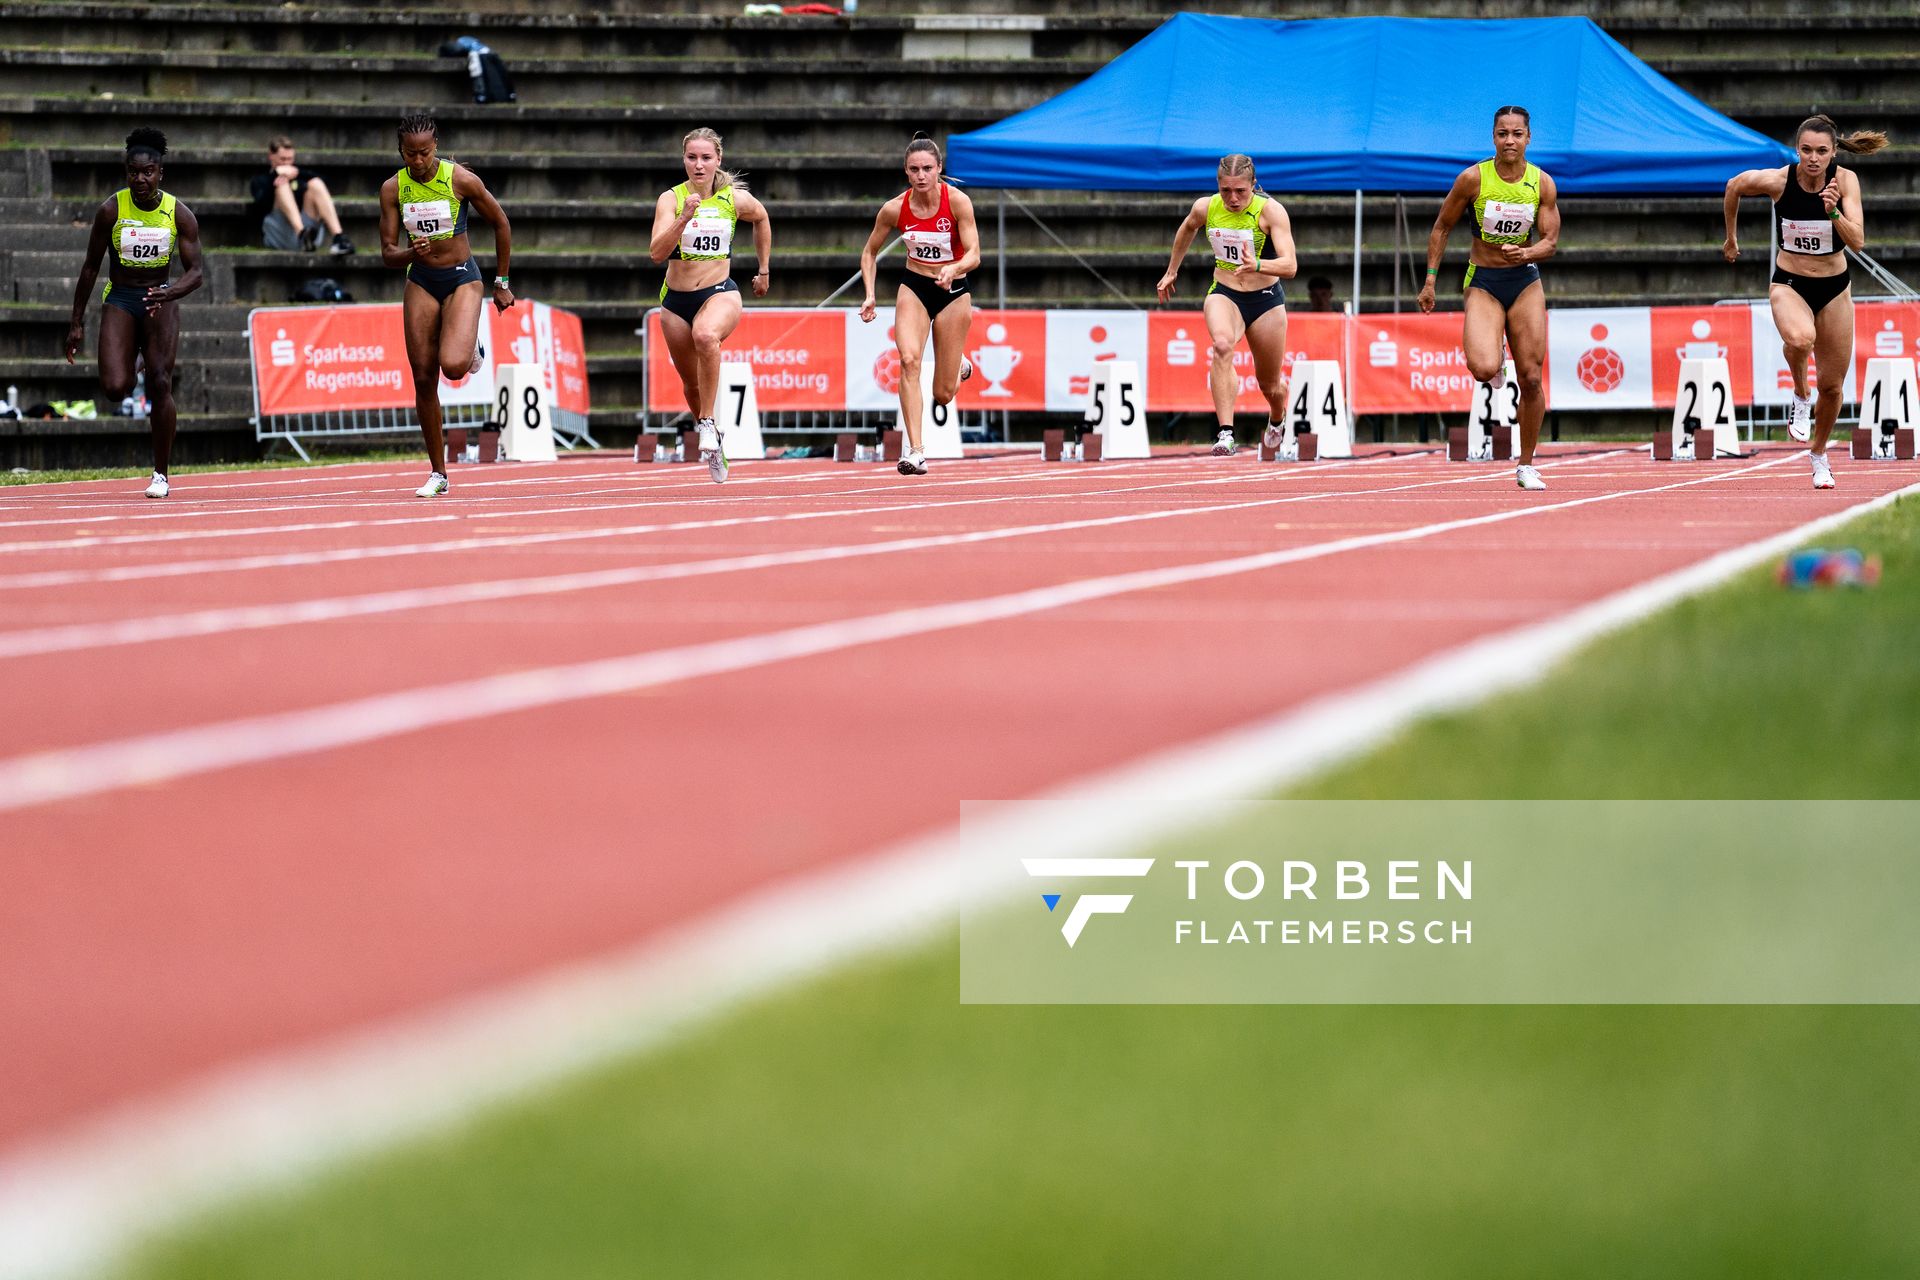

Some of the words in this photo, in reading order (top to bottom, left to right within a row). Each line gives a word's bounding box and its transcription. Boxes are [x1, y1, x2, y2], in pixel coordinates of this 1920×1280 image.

[416, 219, 439, 233] 457
[692, 236, 720, 251] 439
[1494, 220, 1521, 234] 462
[1794, 237, 1820, 251] 459
[133, 245, 159, 259] 624
[1223, 245, 1239, 260] 79
[304, 343, 384, 368] Sparkasse
[720, 345, 808, 365] parkasse
[1409, 346, 1467, 370] Spark
[305, 367, 402, 393] Regensburg
[753, 369, 828, 393] nsburg
[1410, 371, 1473, 395] Regen
[498, 386, 509, 429] 8
[523, 386, 541, 429] 8
[730, 385, 747, 427] 7
[1092, 383, 1105, 426] 5
[1120, 383, 1135, 426] 5
[1293, 382, 1308, 424] 4
[1322, 382, 1337, 426] 4
[1479, 382, 1493, 424] 3
[1506, 381, 1519, 425] 3
[1682, 381, 1698, 424] 2
[1712, 381, 1729, 424] 2
[1871, 380, 1882, 424] 1
[1898, 380, 1909, 423] 1
